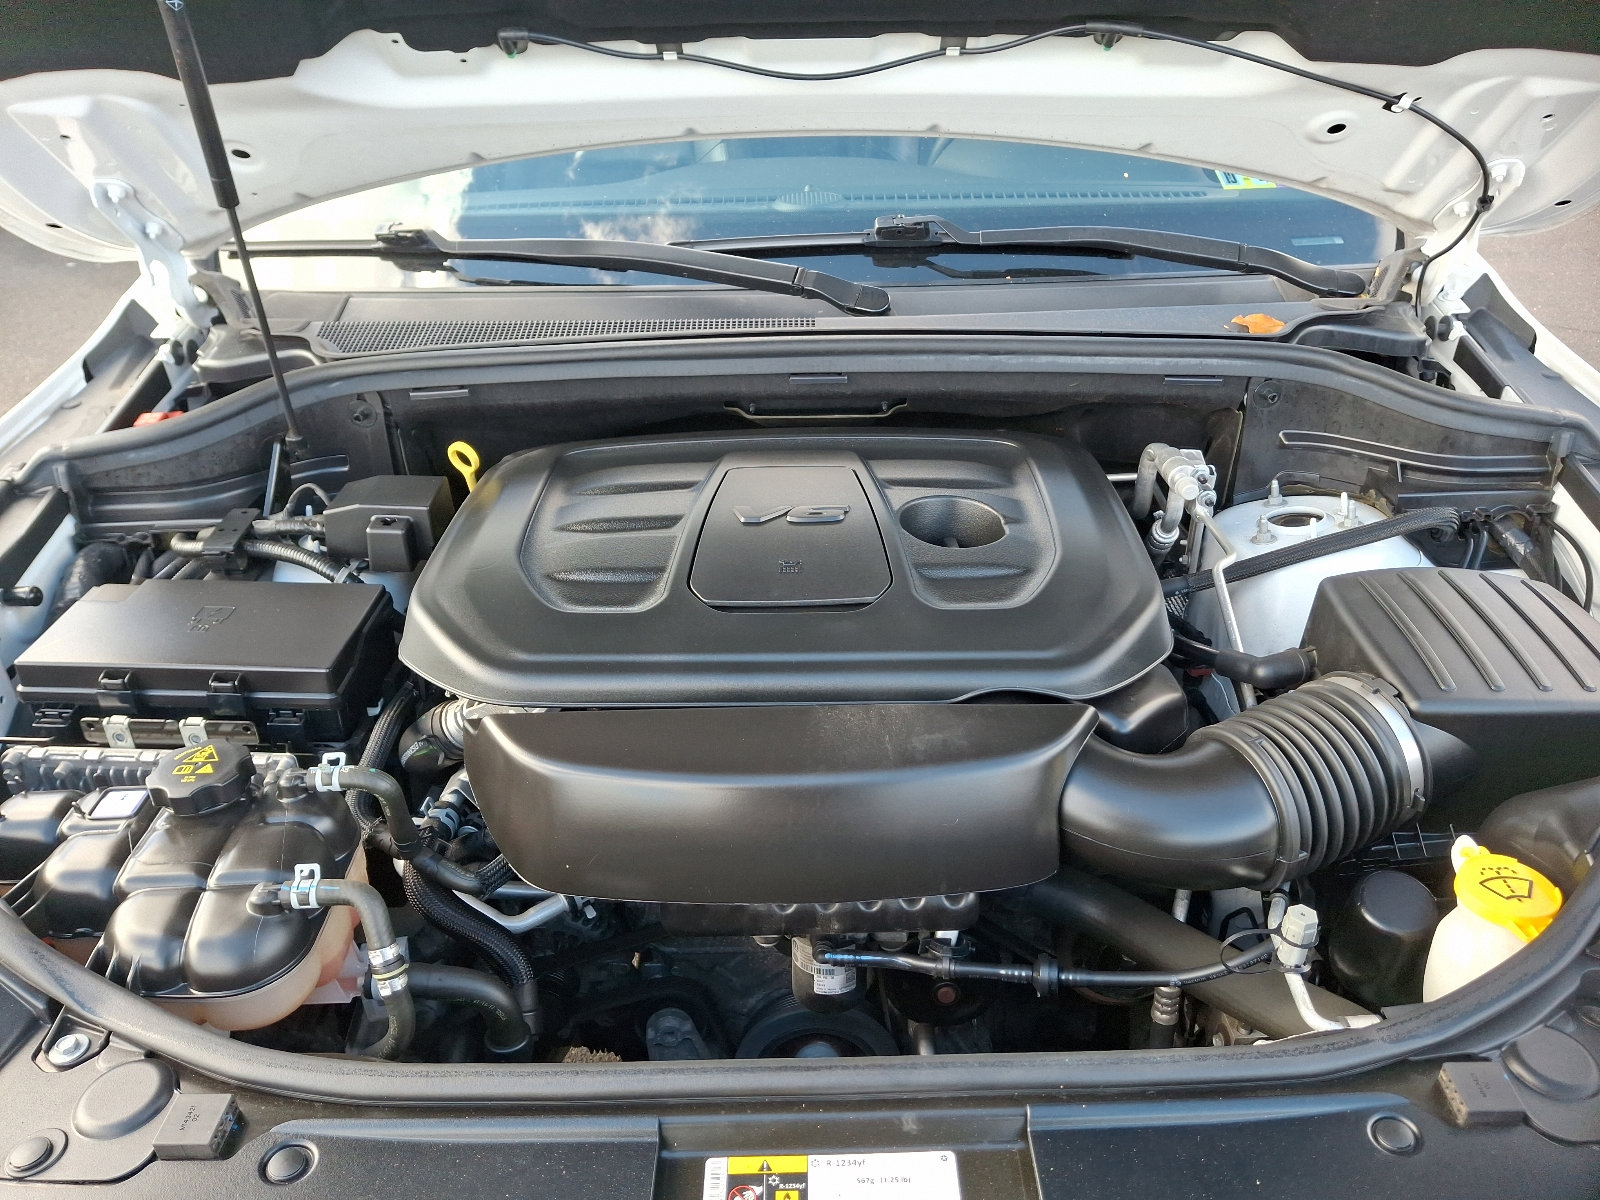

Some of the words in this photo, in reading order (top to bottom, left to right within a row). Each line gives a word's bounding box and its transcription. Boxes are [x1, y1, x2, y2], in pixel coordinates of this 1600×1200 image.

[732, 504, 851, 525] V6
[826, 1158, 866, 1168] R-1234yf
[856, 1177, 875, 1185] 567g
